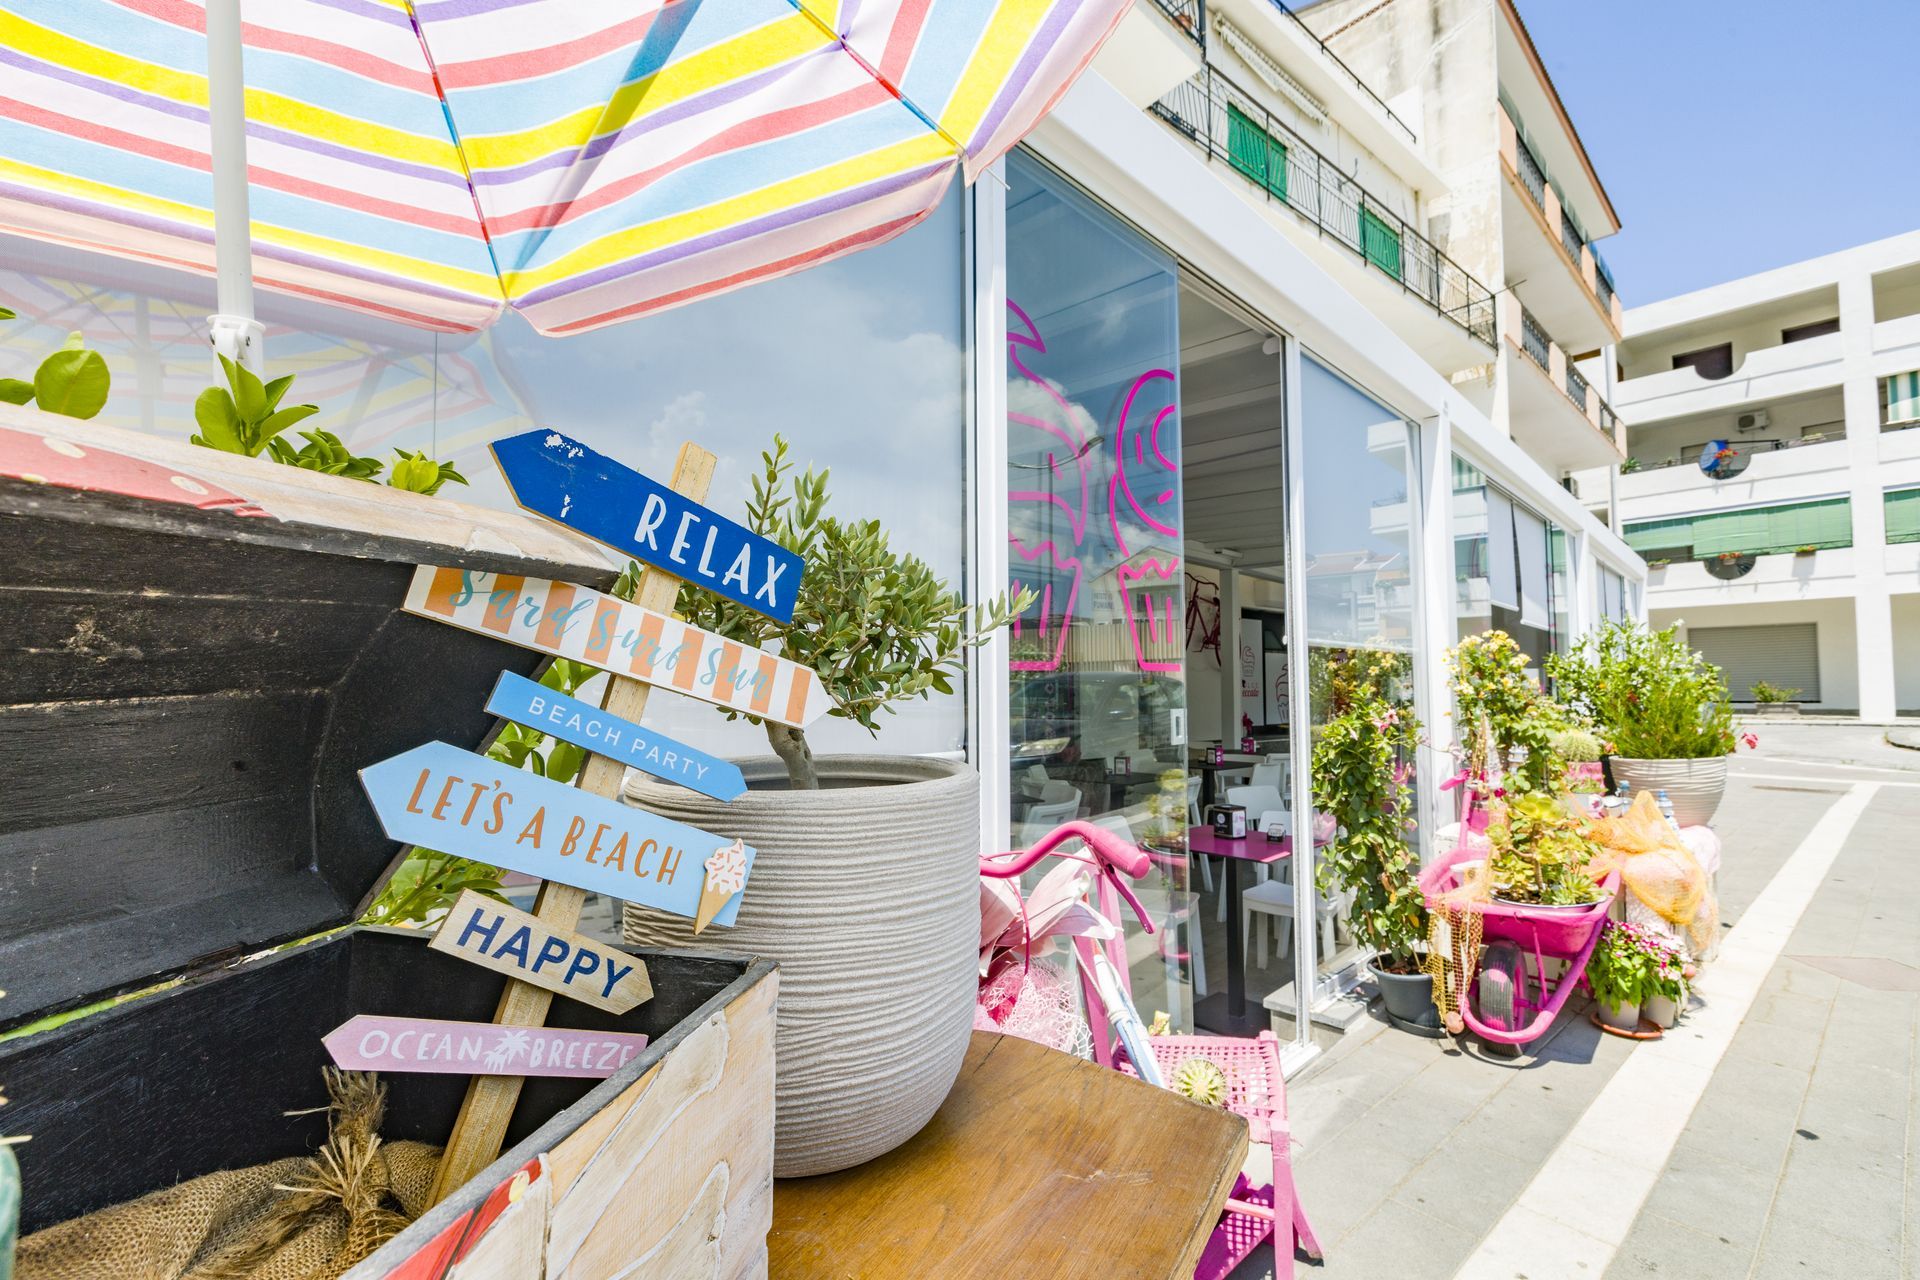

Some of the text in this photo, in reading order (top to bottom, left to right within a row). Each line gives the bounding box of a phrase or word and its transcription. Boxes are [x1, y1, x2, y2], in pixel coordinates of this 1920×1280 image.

[633, 492, 787, 608] RELAX
[699, 647, 774, 700] Sun
[528, 696, 710, 781] BEACH PARTY
[406, 768, 684, 886] LET'S A BEACH
[456, 907, 634, 999] HAPPY
[358, 1029, 634, 1070] OCEAN BREEZE
